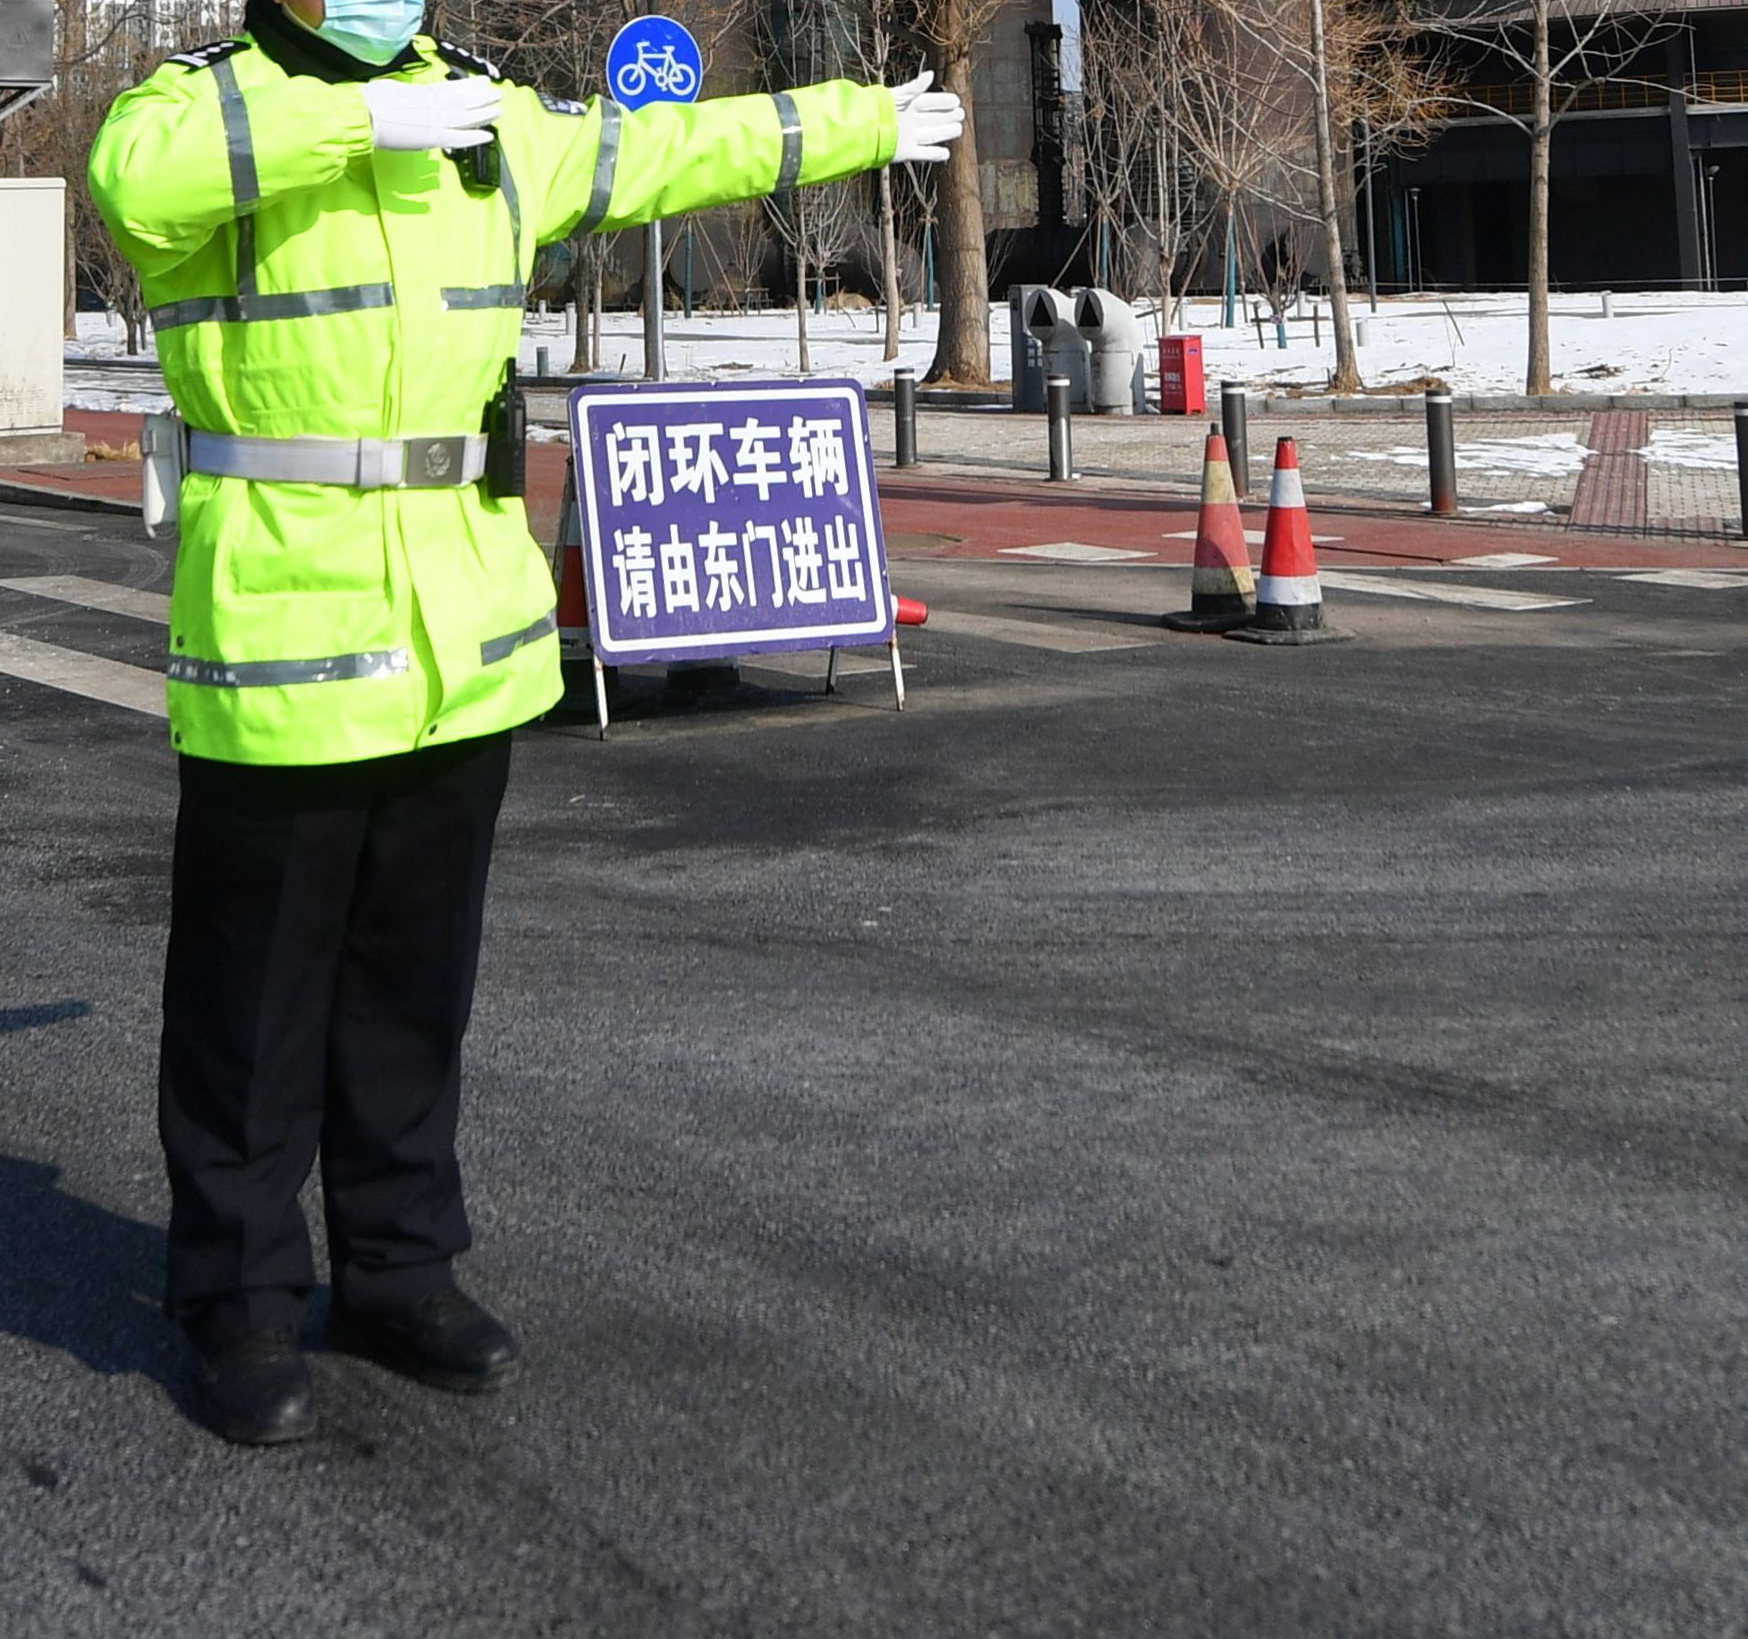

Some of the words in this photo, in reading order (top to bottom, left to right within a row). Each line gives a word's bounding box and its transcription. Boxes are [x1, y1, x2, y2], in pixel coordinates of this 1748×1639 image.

[605, 415, 850, 507] 闭环车辆
[612, 514, 868, 619] 请由东门进出
